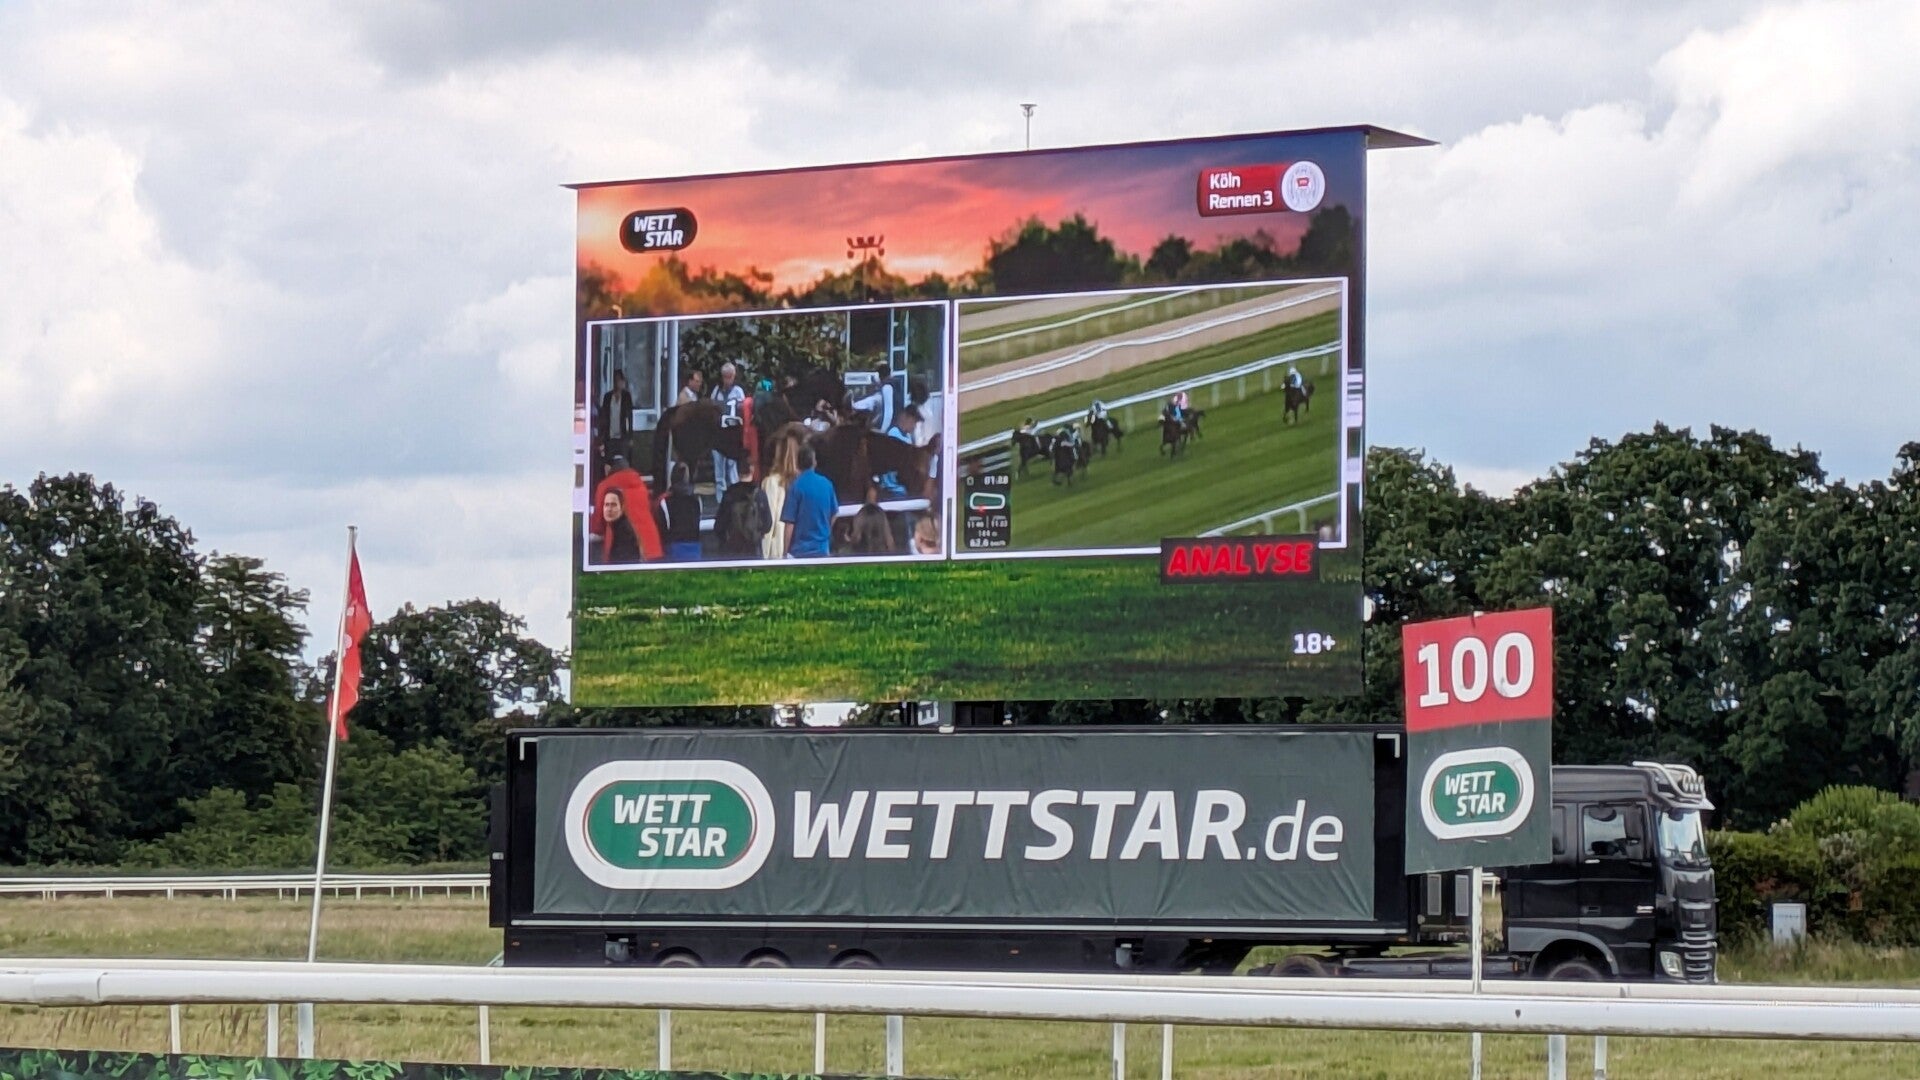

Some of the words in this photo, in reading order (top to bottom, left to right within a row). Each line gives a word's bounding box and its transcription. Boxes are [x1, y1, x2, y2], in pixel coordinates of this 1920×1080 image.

[1210, 172, 1241, 190] Köln
[1209, 193, 1261, 210] Rennen
[1263, 190, 1273, 206] 3
[633, 213, 677, 233] WETT
[643, 229, 684, 248] STAR
[1167, 543, 1313, 576] ANALYSE
[1293, 632, 1336, 655] 18+
[1418, 632, 1535, 708] 100
[1445, 770, 1496, 796] WETT
[613, 794, 711, 824] WETT
[1456, 792, 1506, 818] STAR
[793, 789, 1344, 862] WETTSTAR.de
[637, 827, 728, 858] STAR
